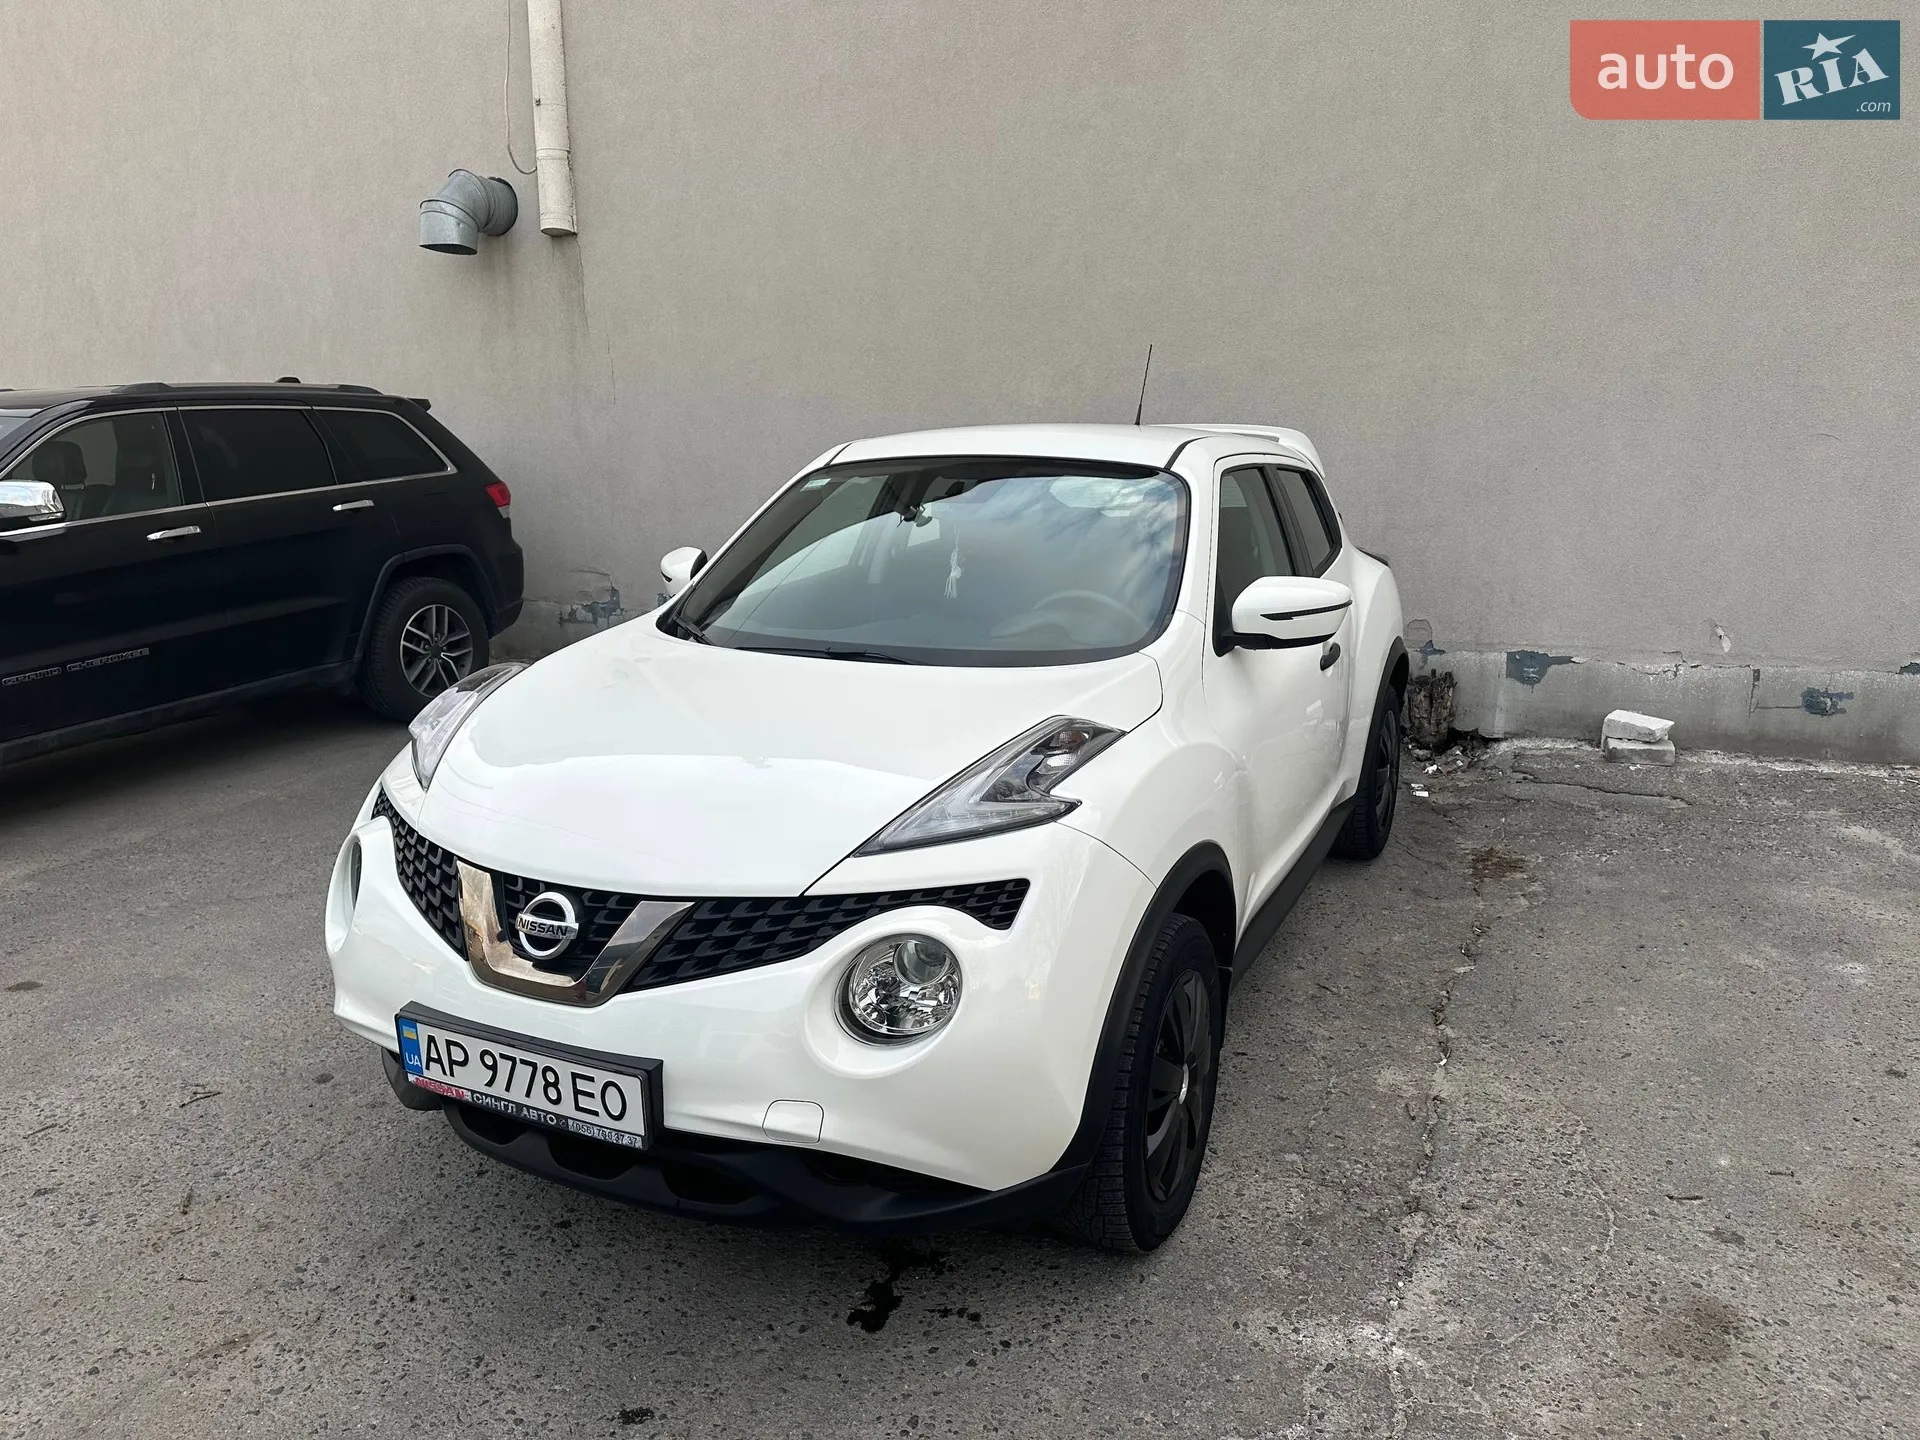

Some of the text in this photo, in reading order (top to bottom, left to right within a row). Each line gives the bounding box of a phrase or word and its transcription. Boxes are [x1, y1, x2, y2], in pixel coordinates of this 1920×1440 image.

[2, 647, 150, 686] GRAND CHEROKEE
[517, 917, 568, 936] NISSAN
[405, 1052, 421, 1067] UA
[425, 1034, 627, 1121] AP 9778 EO
[473, 1093, 557, 1125] СИНГЛ АВТО
